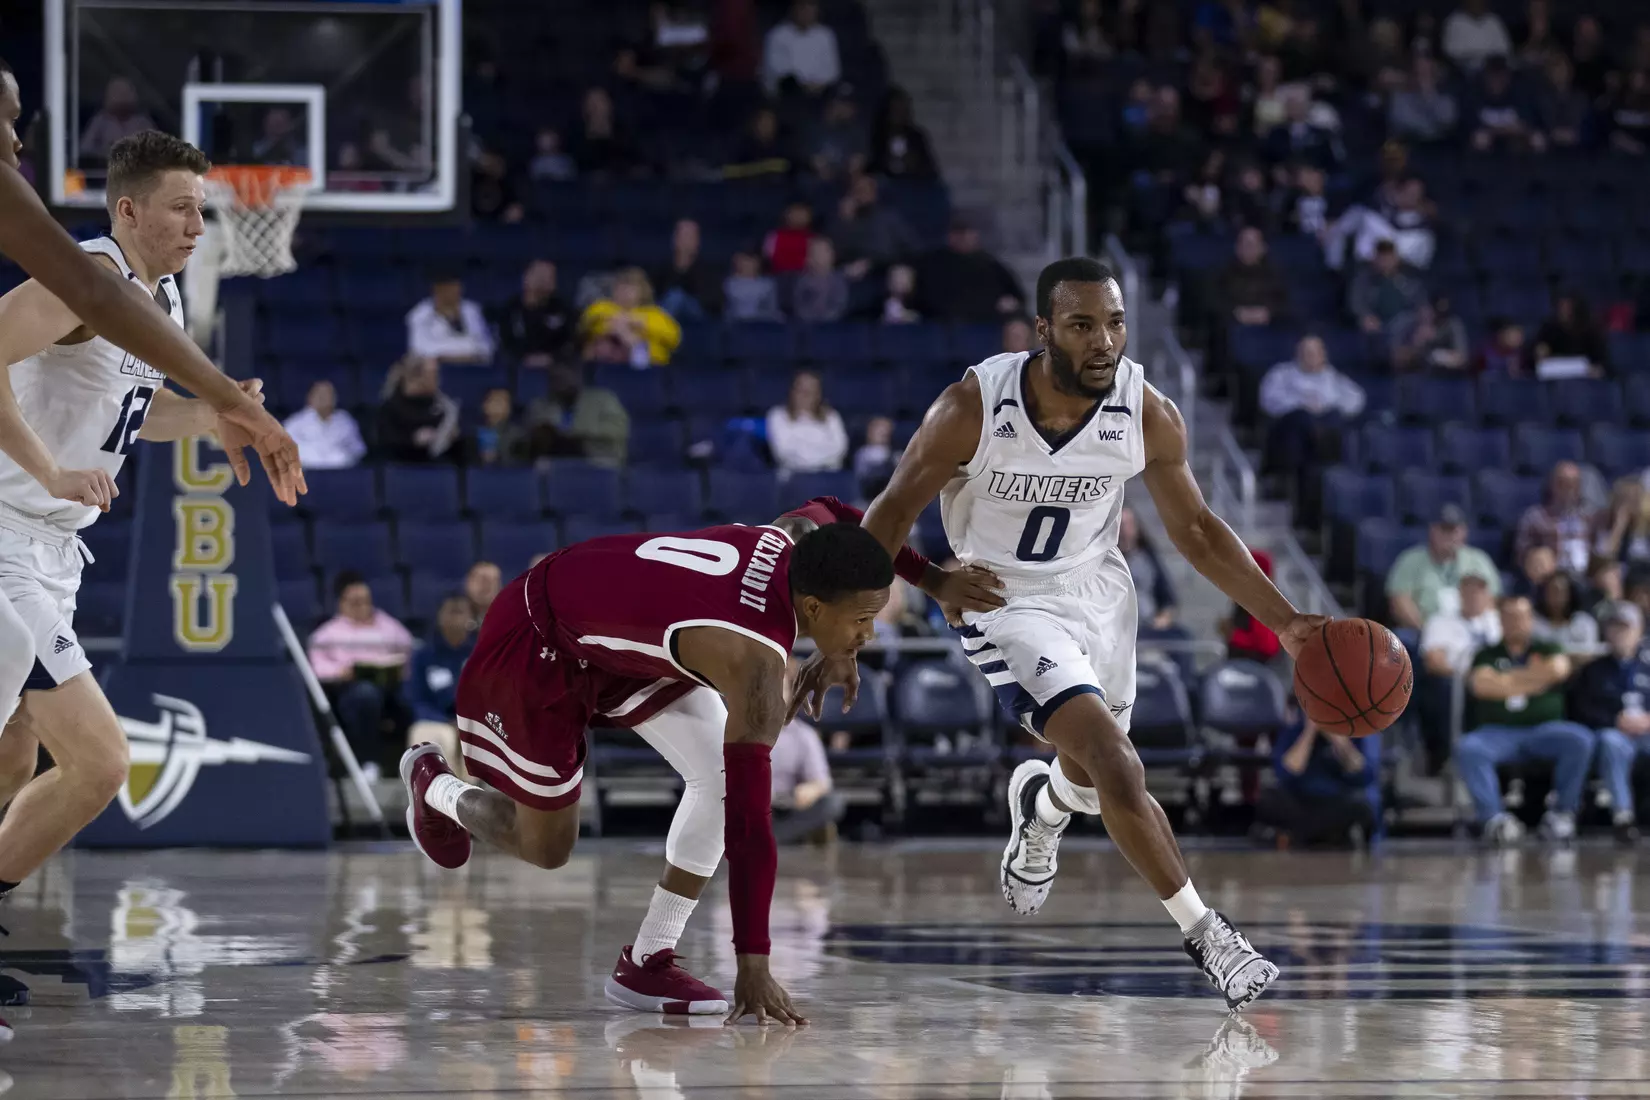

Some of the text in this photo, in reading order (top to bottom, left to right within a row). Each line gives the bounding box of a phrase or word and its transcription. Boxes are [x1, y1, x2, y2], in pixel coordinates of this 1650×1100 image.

[100, 385, 154, 455] 12
[1098, 430, 1124, 441] WAC
[988, 470, 1112, 503] LANCERS
[169, 428, 238, 653] CBU
[1016, 506, 1071, 562] 0
[635, 536, 740, 577] 0
[1035, 661, 1059, 677] adidas
